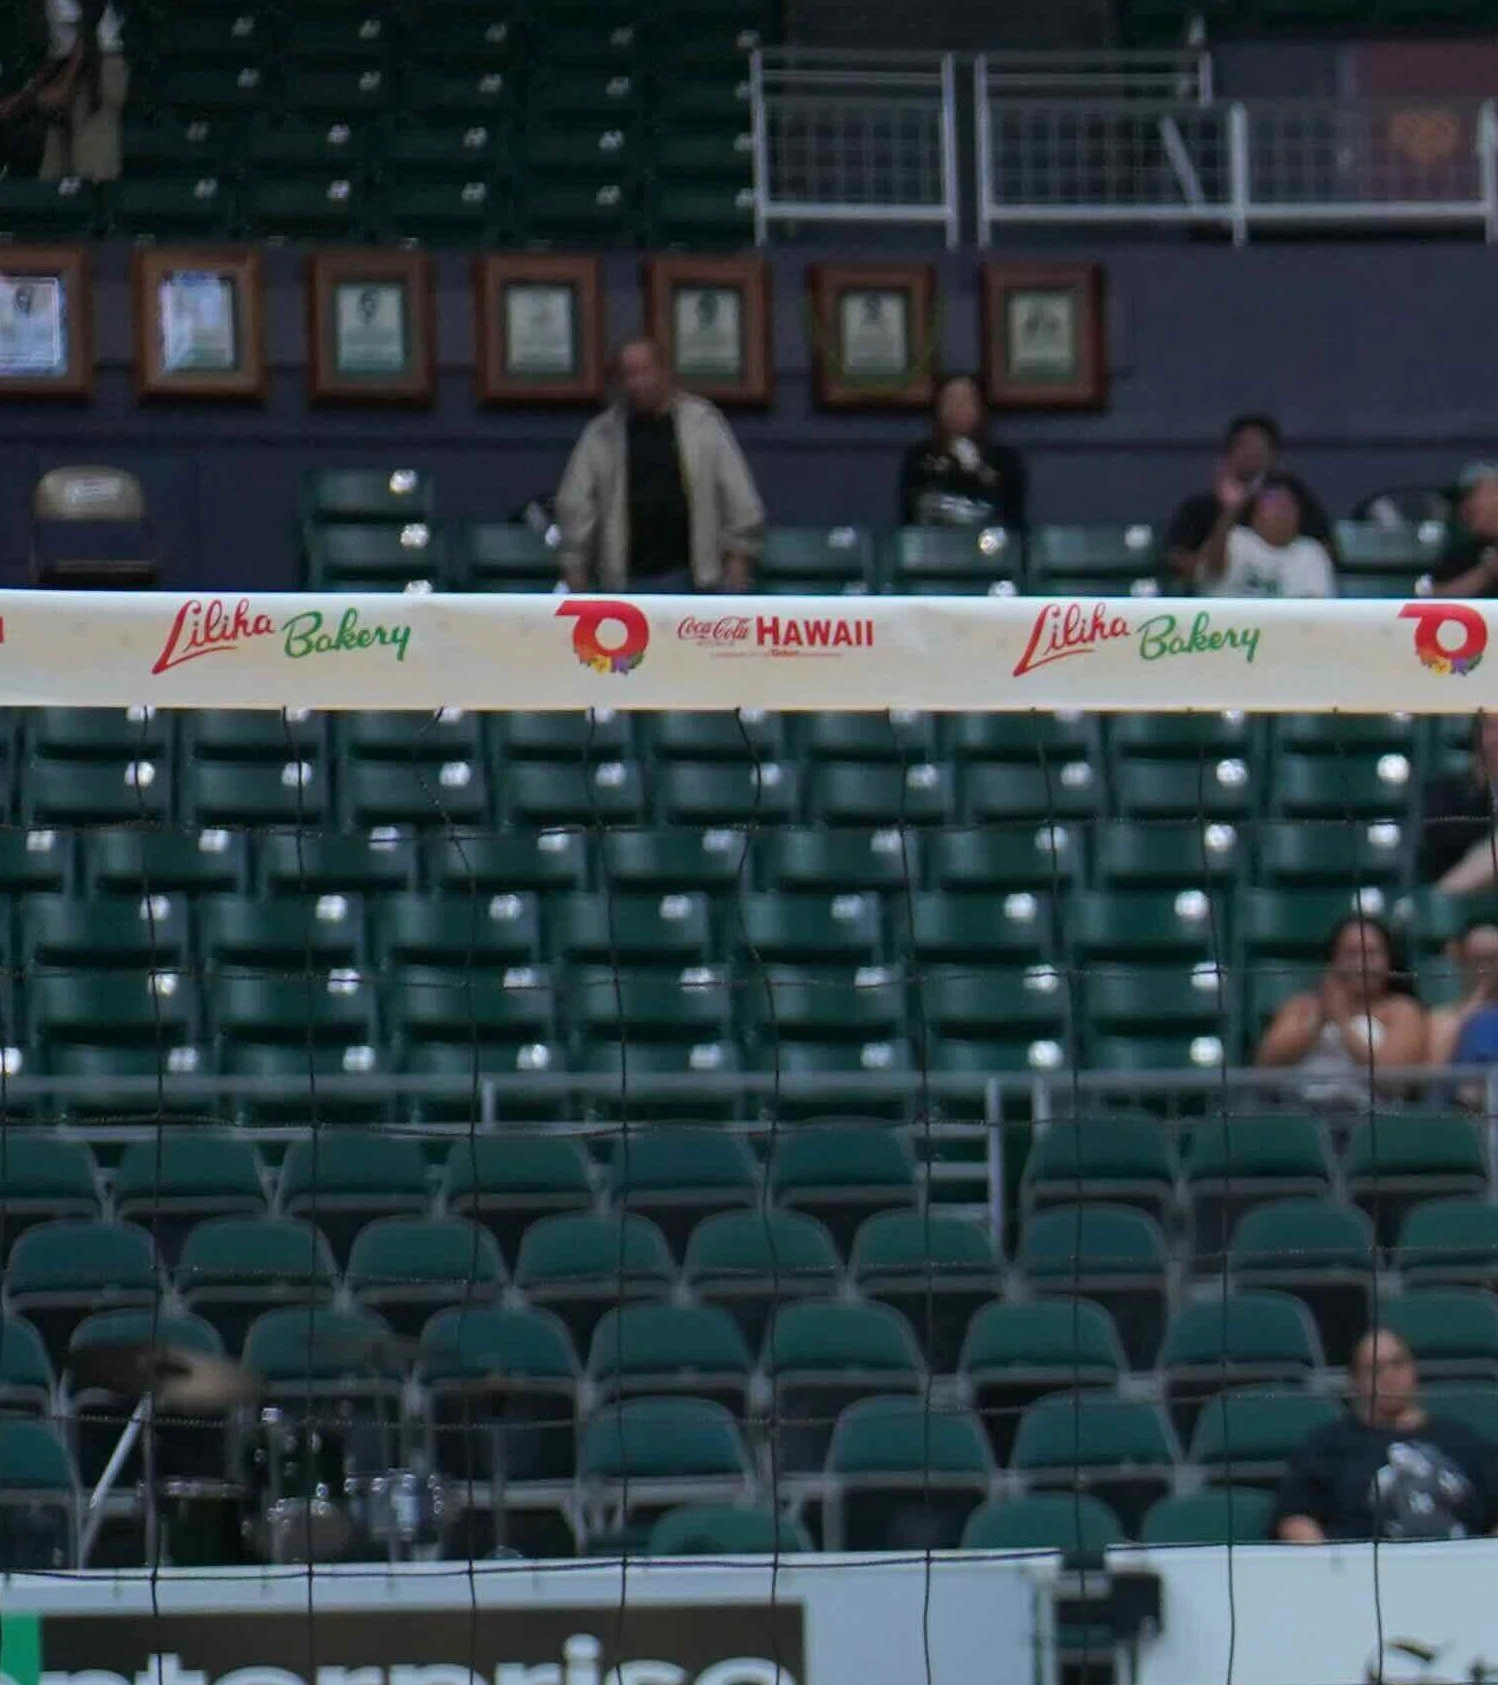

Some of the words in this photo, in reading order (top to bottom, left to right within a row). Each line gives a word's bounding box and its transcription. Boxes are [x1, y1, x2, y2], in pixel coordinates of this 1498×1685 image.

[153, 600, 274, 674] Liliha
[283, 609, 410, 661] Bakery
[757, 616, 874, 647] HAWAII
[1012, 603, 1131, 676] Liliha
[1137, 612, 1261, 662] Bakery
